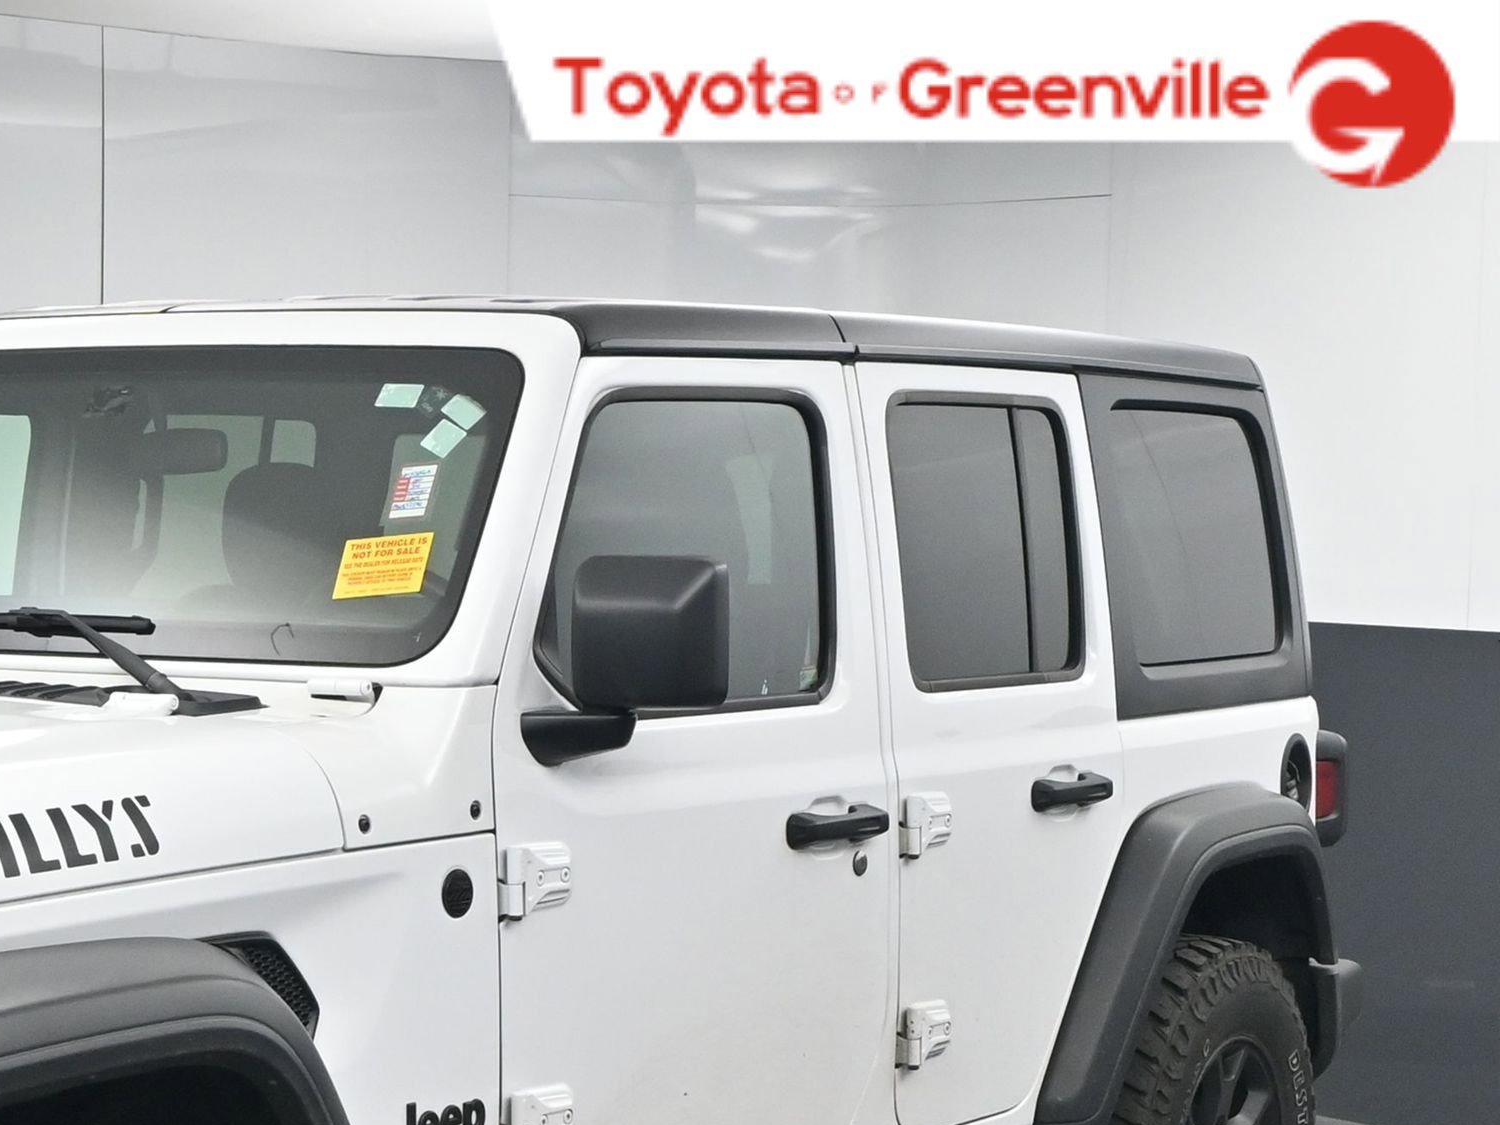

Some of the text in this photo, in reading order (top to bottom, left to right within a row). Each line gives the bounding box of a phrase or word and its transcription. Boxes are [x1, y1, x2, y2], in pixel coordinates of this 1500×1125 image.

[350, 537, 428, 551] THIS VEHICLE IS
[352, 546, 421, 559] NOT FOR SALE
